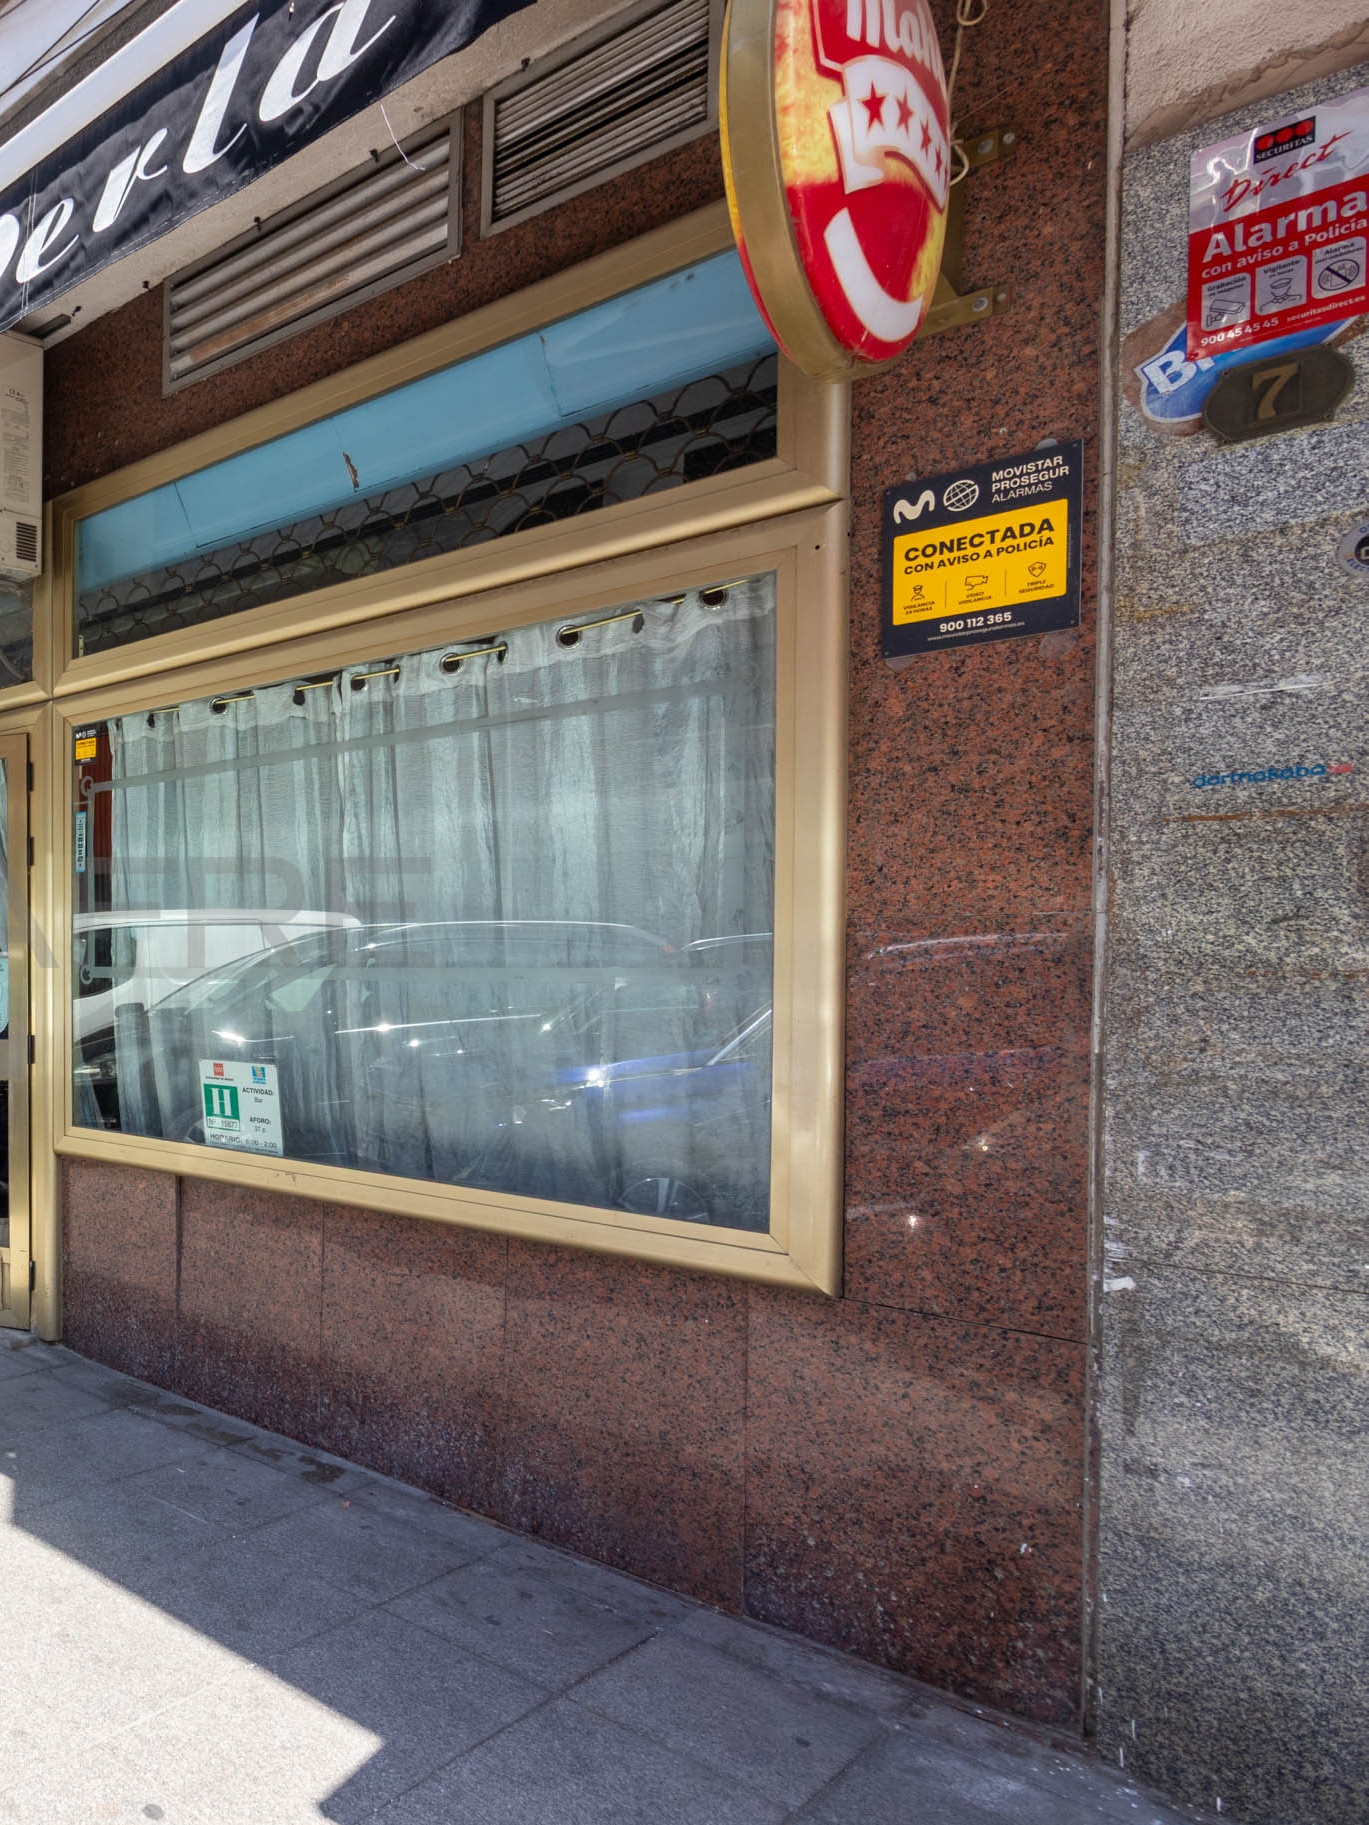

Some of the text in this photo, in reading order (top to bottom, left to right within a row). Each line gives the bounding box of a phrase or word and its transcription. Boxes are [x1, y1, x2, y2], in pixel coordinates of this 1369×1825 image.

[1255, 134, 1314, 162] SECURITAS
[1220, 130, 1352, 213] Direct
[1201, 217, 1368, 279] con aviso a Policía
[1200, 331, 1225, 348] 900
[1226, 326, 1243, 340] 45
[1244, 321, 1261, 336] 45
[1262, 317, 1280, 331] 45
[1250, 361, 1300, 421] 7
[991, 465, 1070, 493] PROSEGUR
[992, 455, 1064, 482] MOVISTAR
[991, 481, 1053, 503] ALARMAS
[904, 518, 1055, 562] CONECTADA
[904, 536, 1054, 575] CON AVISO A POLICÍA
[939, 611, 1012, 633] 900 112 365
